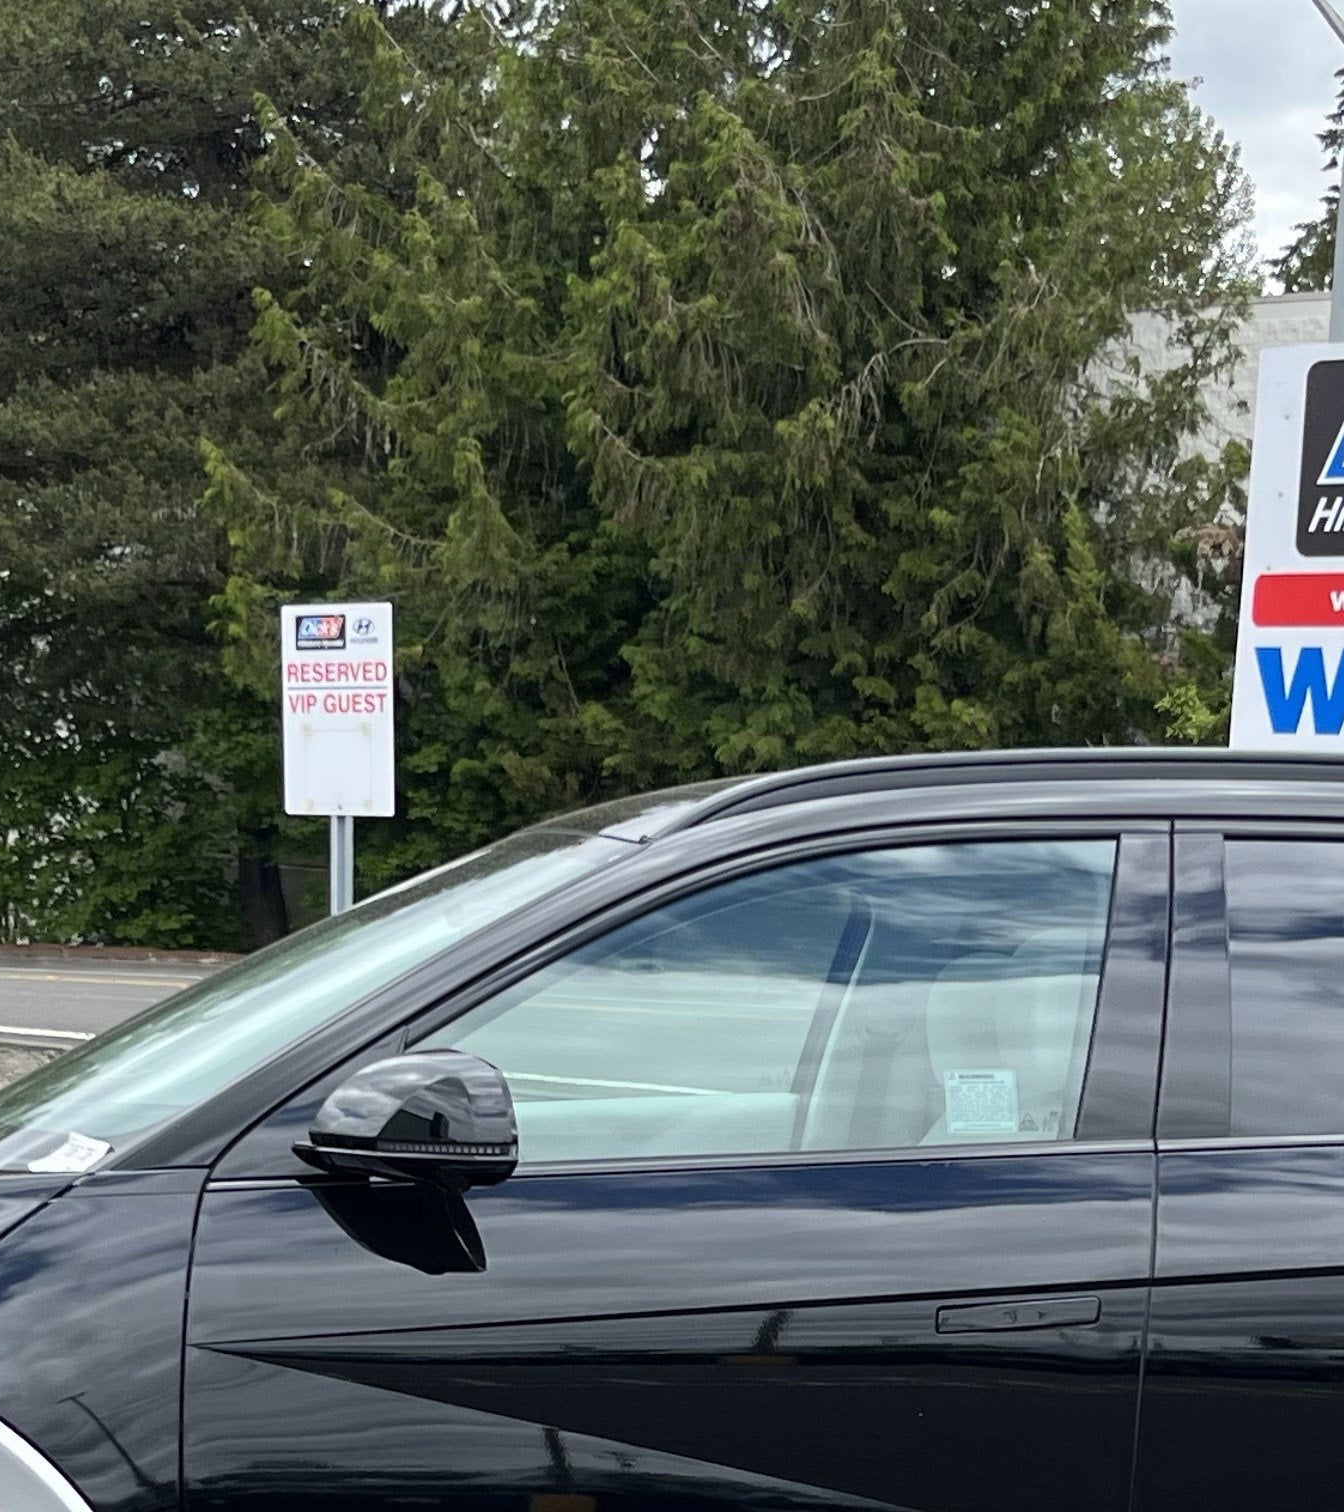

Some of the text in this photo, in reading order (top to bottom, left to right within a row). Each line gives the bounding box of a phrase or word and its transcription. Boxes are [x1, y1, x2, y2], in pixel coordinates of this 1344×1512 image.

[287, 661, 388, 683] RESERVED
[288, 692, 388, 713] VIP GUEST
